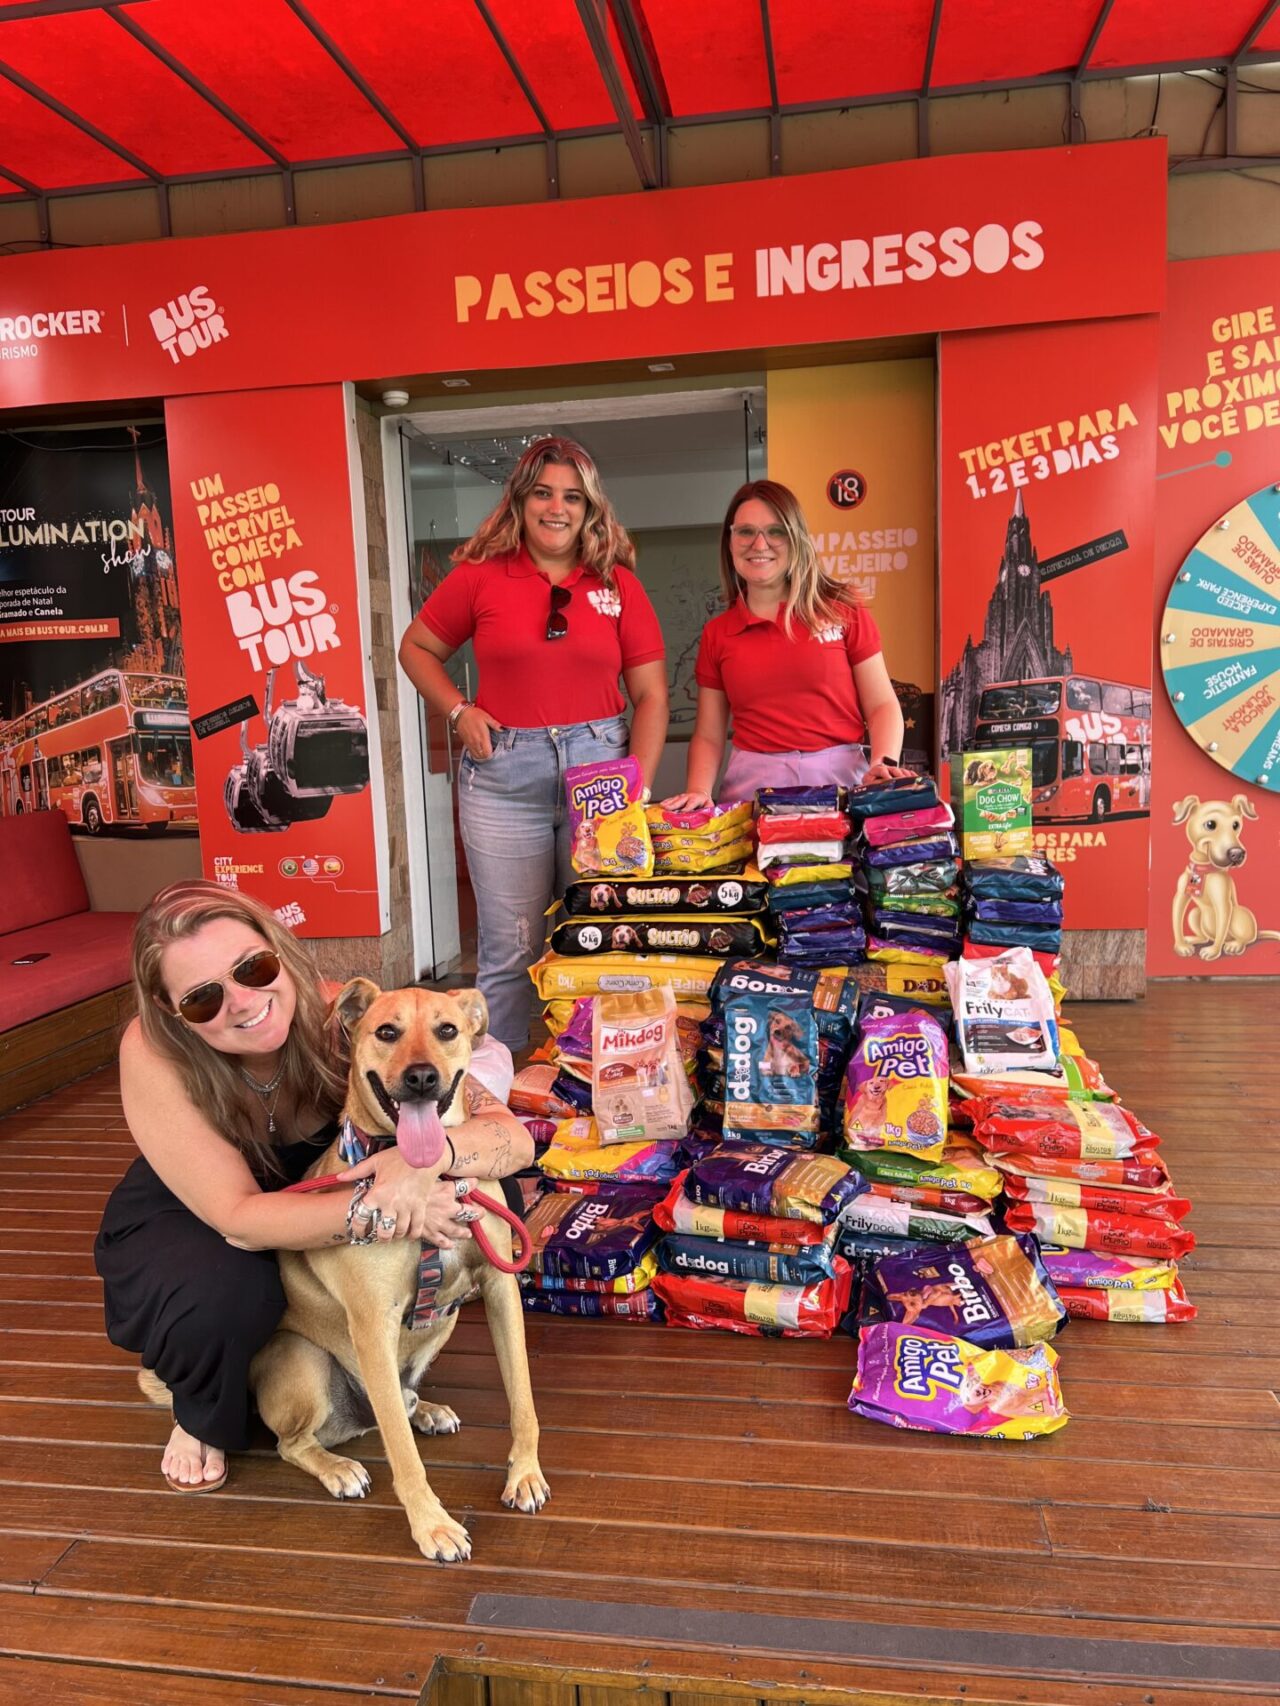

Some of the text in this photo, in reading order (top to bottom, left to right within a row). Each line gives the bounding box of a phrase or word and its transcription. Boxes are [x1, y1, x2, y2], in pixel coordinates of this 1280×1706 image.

[454, 220, 1045, 323] PASSEIOS E INGRESSOS
[149, 285, 216, 343] BUS
[1212, 306, 1276, 343] GIRE
[161, 314, 230, 364] TOUR
[1207, 350, 1226, 377] E
[1166, 369, 1280, 418] PRÓXIM
[959, 402, 1138, 475] TICKET PARA
[1159, 403, 1240, 449] VOCÊ
[966, 434, 1120, 500] 1, 2 E 3 DIAS
[190, 473, 224, 501] UM
[834, 477, 859, 503] 18
[196, 482, 280, 526] PASSEIO
[204, 505, 296, 550] INCRÍVEL
[828, 528, 918, 552] PASSEIO
[101, 532, 151, 574] show
[211, 528, 303, 570] COMEÇA
[218, 561, 265, 592] COM
[1232, 544, 1275, 585] OLIVAS DE
[14, 586, 55, 598] espetáculo
[56, 586, 67, 595] da
[22, 598, 31, 607] de
[32, 597, 53, 606] Natal
[226, 570, 326, 638] BUS
[1196, 578, 1278, 615] EXPERIENCE PARK
[1216, 596, 1252, 615] EXCEED
[34, 607, 63, 616] Canela
[6, 628, 23, 637] MAIS
[24, 627, 36, 636] EM
[37, 624, 109, 635] BUSTOUR.COM.BR
[238, 613, 341, 672] TOUR
[1190, 638, 1254, 648] CRISTAIS DE
[1192, 627, 1254, 638] GRAMADO
[1204, 664, 1257, 700] FANTASTIC
[1205, 662, 1242, 687] HOUSE
[1222, 684, 1269, 731] JOLIMONT
[1065, 710, 1121, 743] BUS
[576, 779, 621, 803] Amigo
[587, 793, 627, 818] Pet
[1060, 832, 1106, 847] PARA
[214, 856, 233, 865] CITY
[215, 864, 264, 874] EXPERIENCE
[216, 874, 238, 882] TOUR
[626, 886, 680, 905] SULTÃO
[648, 928, 699, 948] SULTÃO
[966, 1000, 1003, 1018] Frily
[602, 1024, 663, 1050] Mikdog
[871, 1039, 928, 1061] Amigo
[880, 1055, 930, 1077] Pet
[885, 1124, 902, 1137] 1kg
[940, 1178, 957, 1188] Pet
[566, 1202, 609, 1239] Birbo
[846, 1214, 873, 1230] Frily
[873, 1223, 895, 1233] DOG
[948, 1264, 991, 1325] Birbo
[902, 1340, 927, 1391] Amigo
[927, 1342, 960, 1385] Pet
